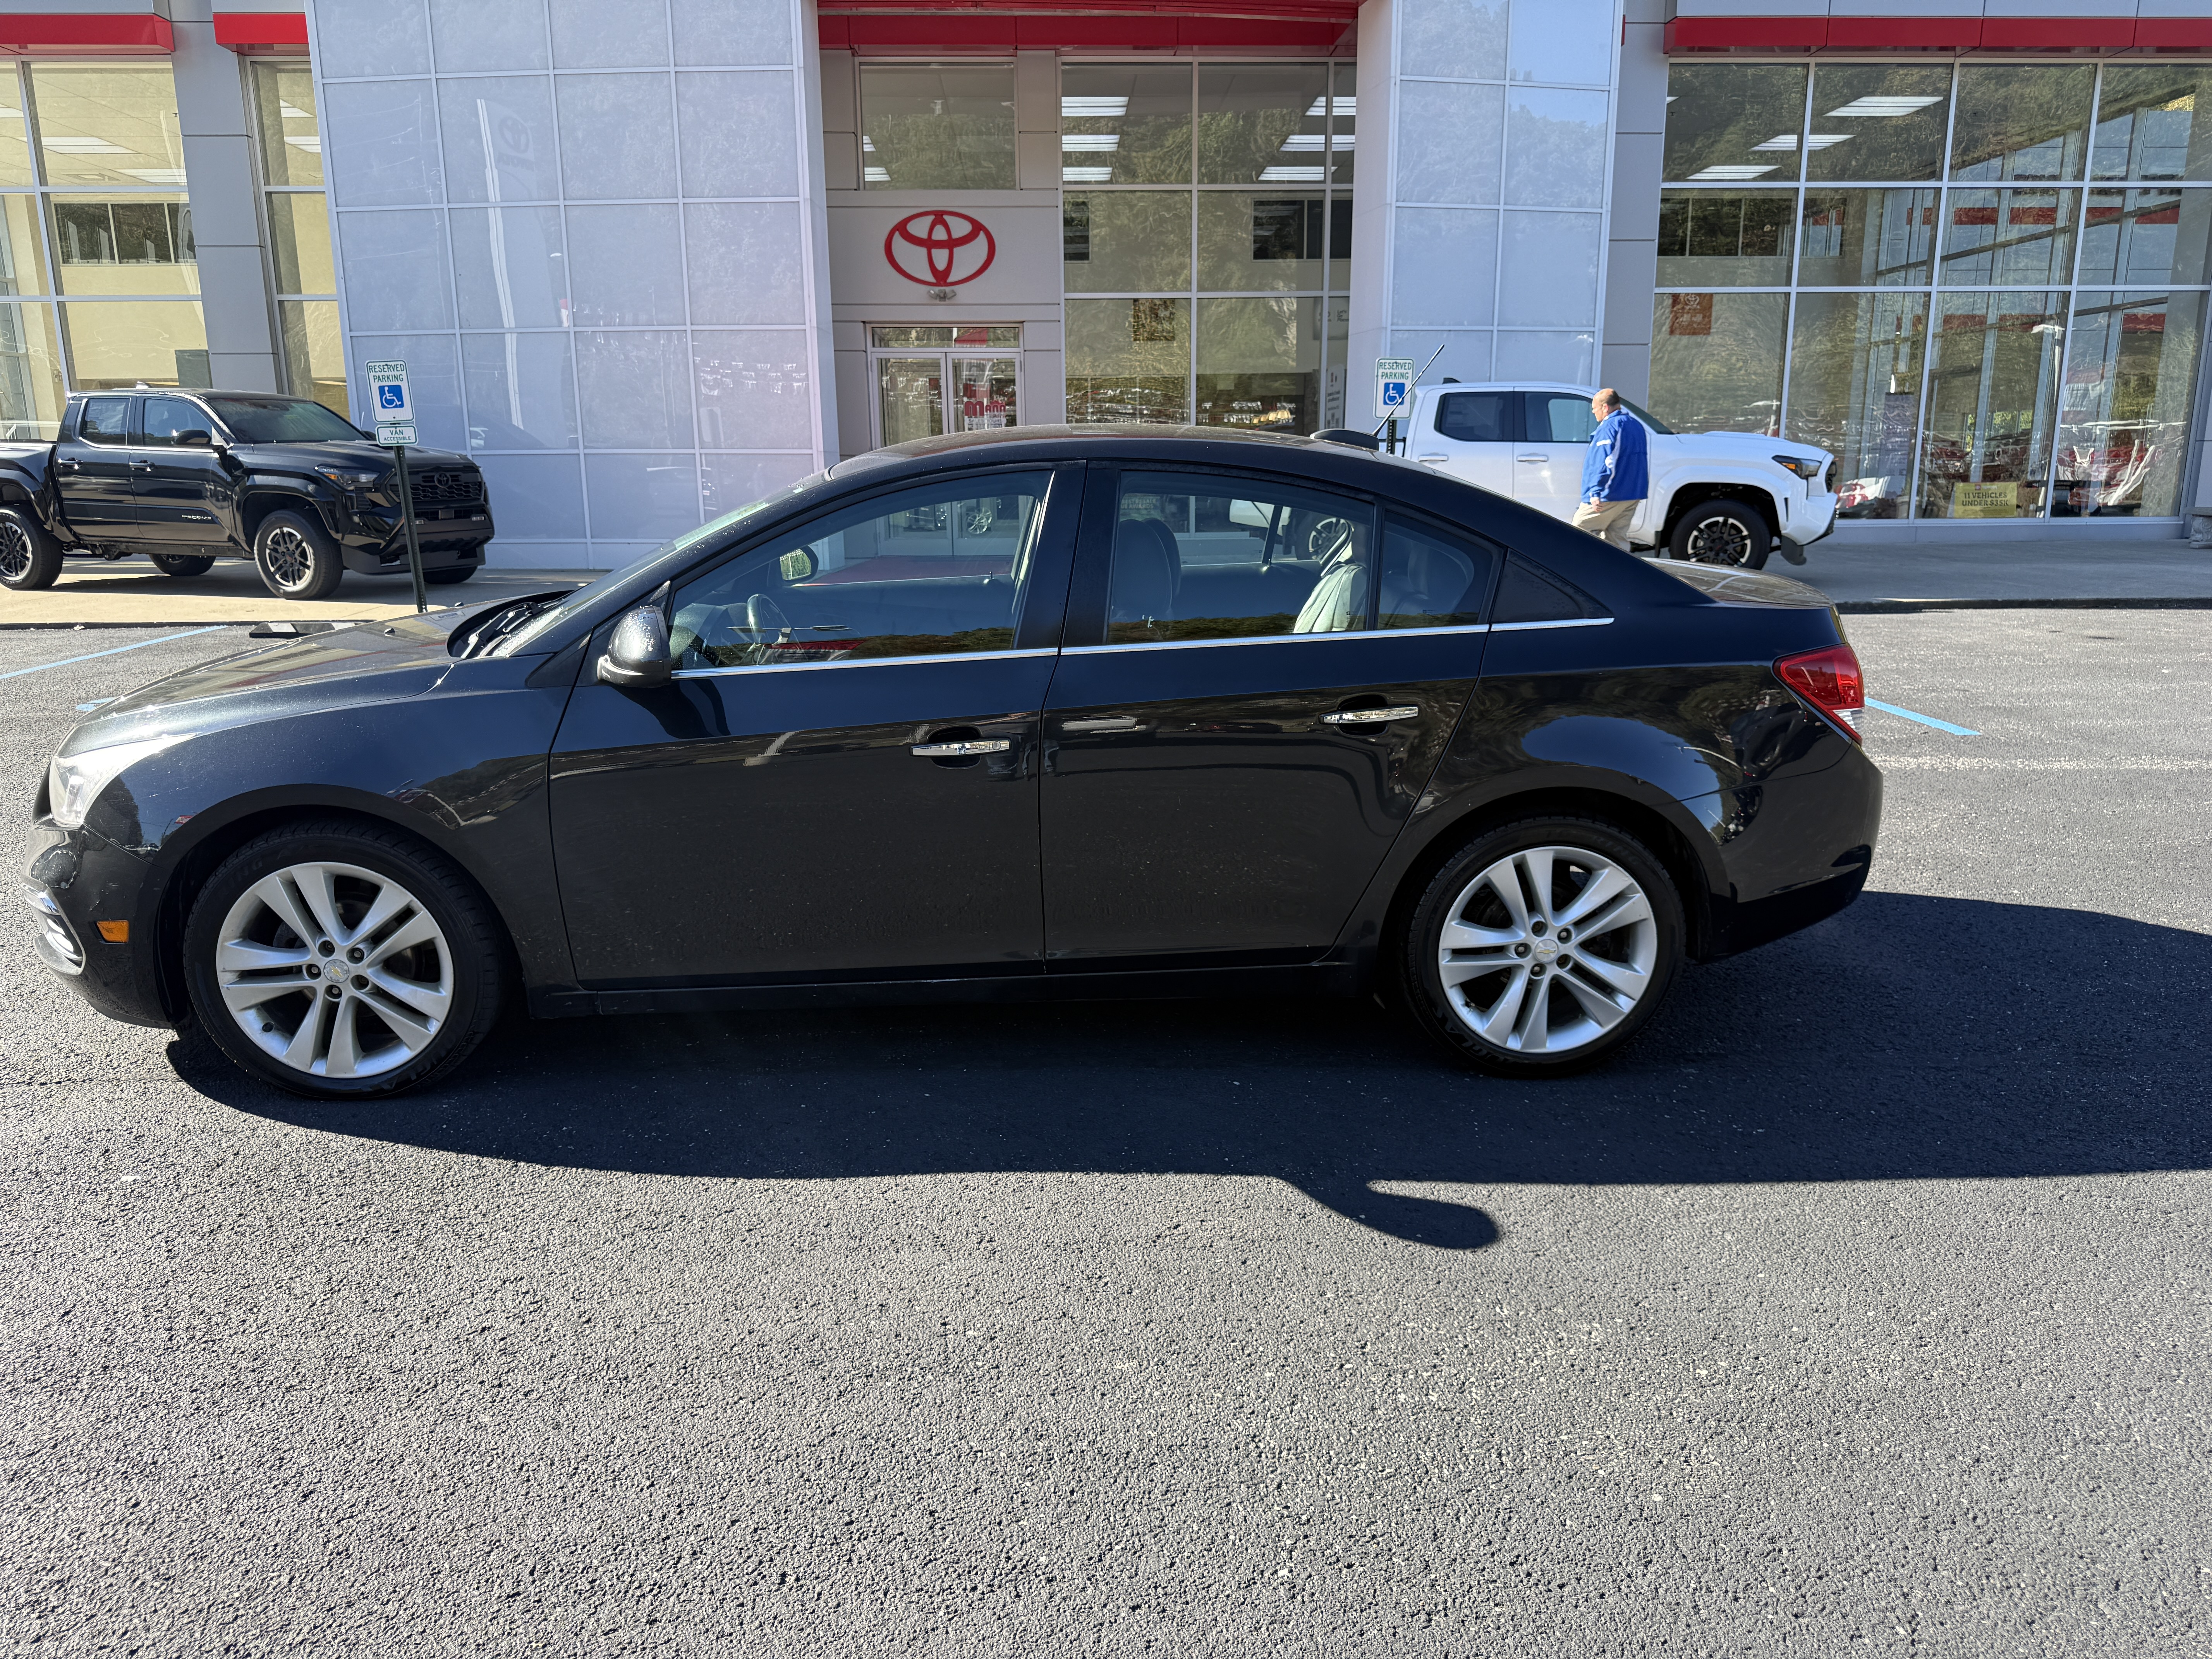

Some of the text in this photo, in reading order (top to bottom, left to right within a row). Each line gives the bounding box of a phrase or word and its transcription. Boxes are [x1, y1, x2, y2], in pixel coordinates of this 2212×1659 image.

[369, 364, 405, 373] RESERVED
[1379, 362, 1412, 370] RESERVED
[373, 374, 404, 383] PARKING
[1381, 372, 1409, 380] PARKING
